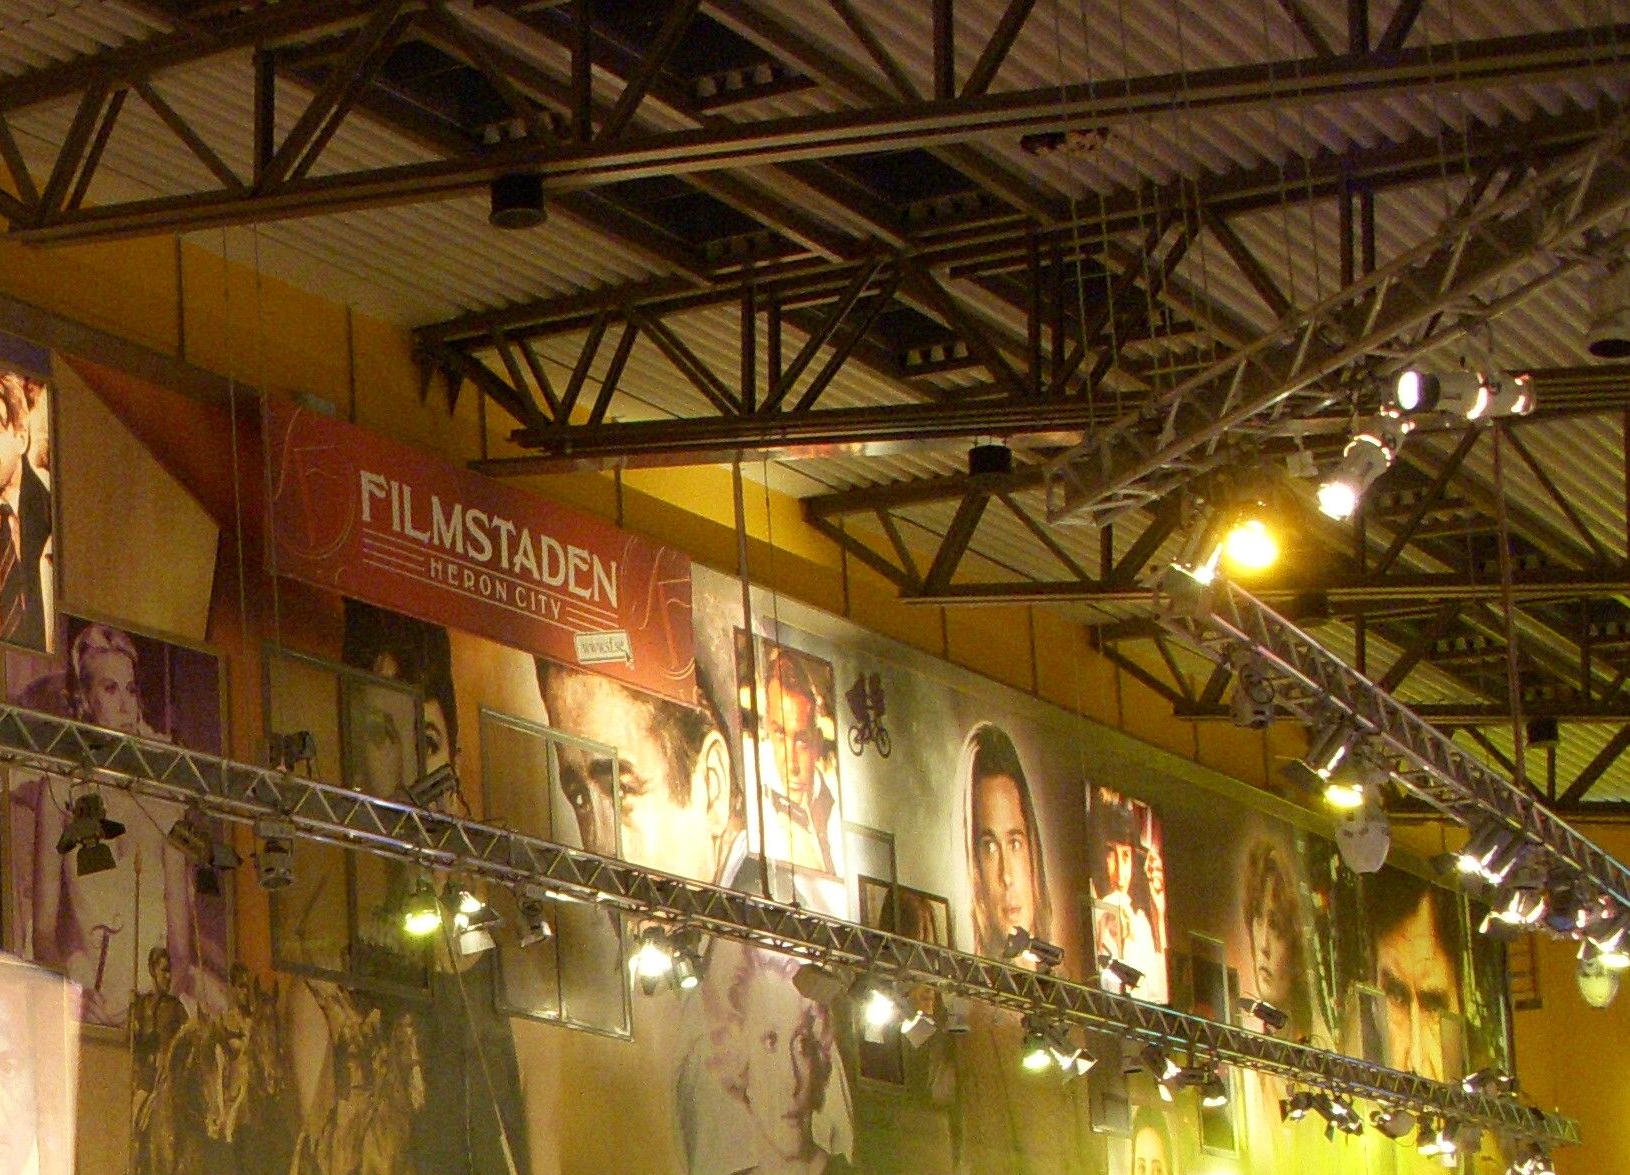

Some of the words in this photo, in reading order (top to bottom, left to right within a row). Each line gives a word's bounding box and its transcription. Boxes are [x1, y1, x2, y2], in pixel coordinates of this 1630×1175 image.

[360, 470, 618, 608] FILMSTADEN
[429, 559, 508, 601] HERON
[515, 587, 562, 620] CITY
